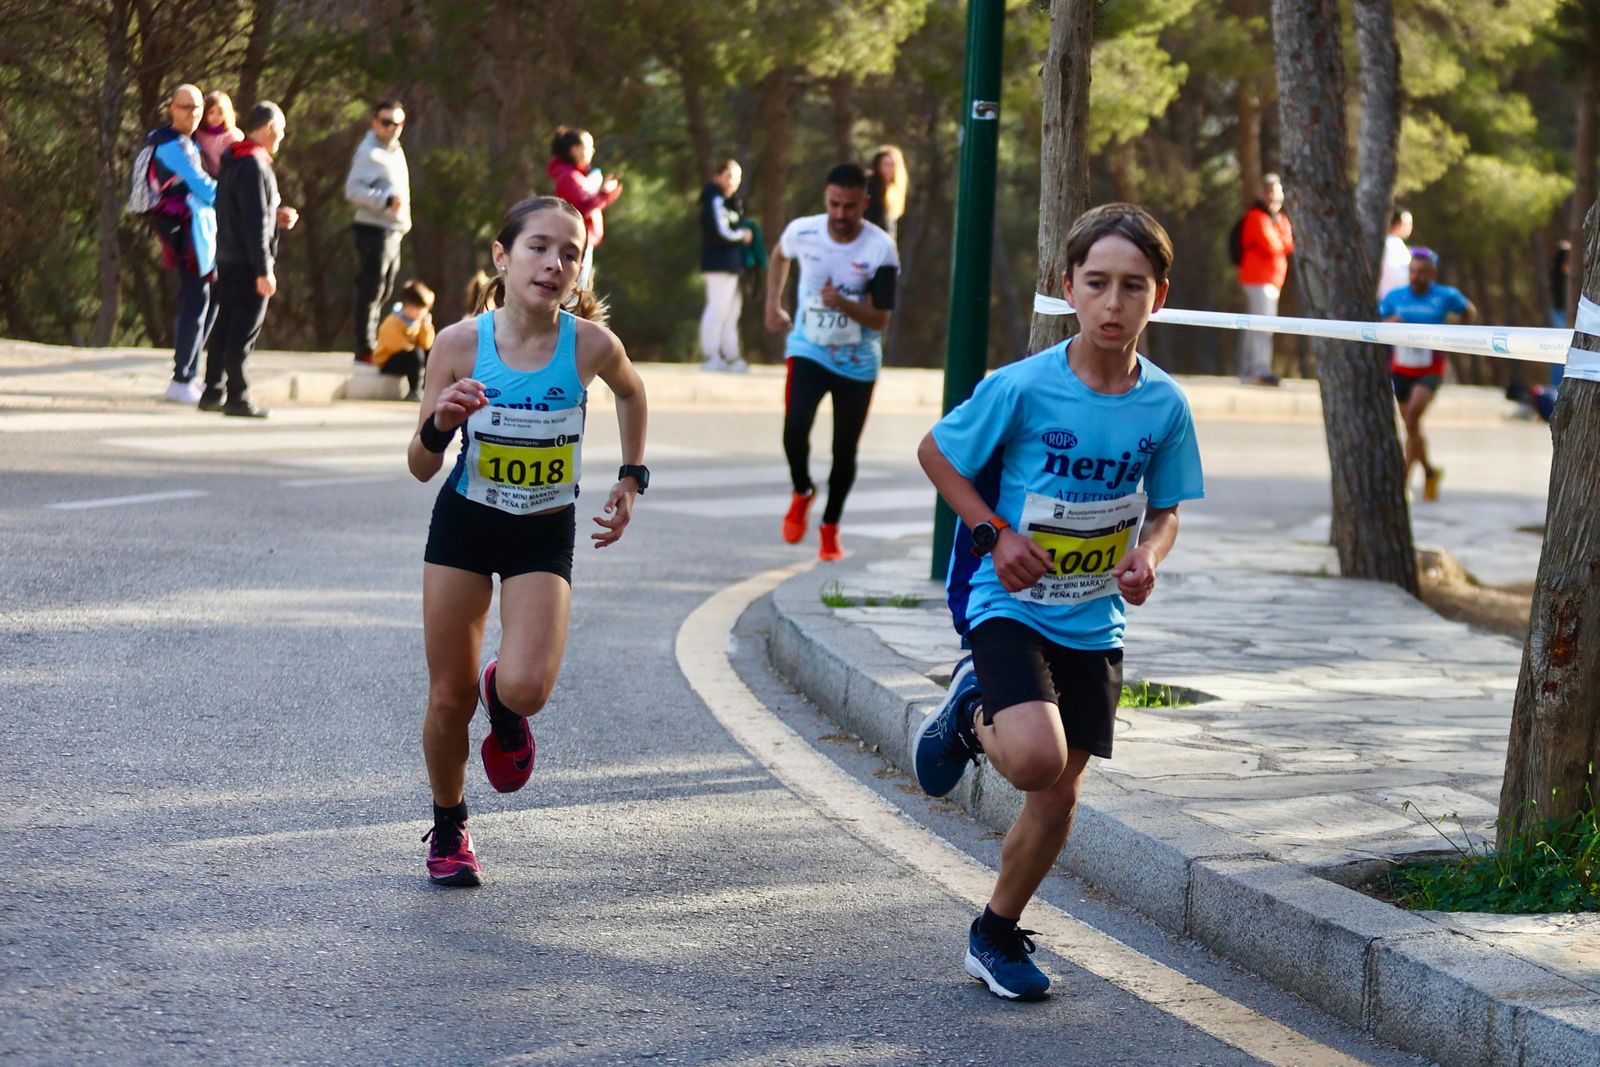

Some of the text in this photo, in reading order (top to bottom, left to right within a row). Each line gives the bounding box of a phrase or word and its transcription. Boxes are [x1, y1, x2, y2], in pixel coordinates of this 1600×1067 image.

[816, 313, 849, 329] 270
[1044, 433, 1077, 447] TROPS
[488, 457, 565, 487] 1018
[1041, 451, 1142, 490] nerja
[501, 498, 520, 509] PEÑA
[512, 493, 528, 501] MINI
[1045, 544, 1116, 576] 1001
[1063, 581, 1079, 589] MINI
[1049, 590, 1071, 599] PEÑA
